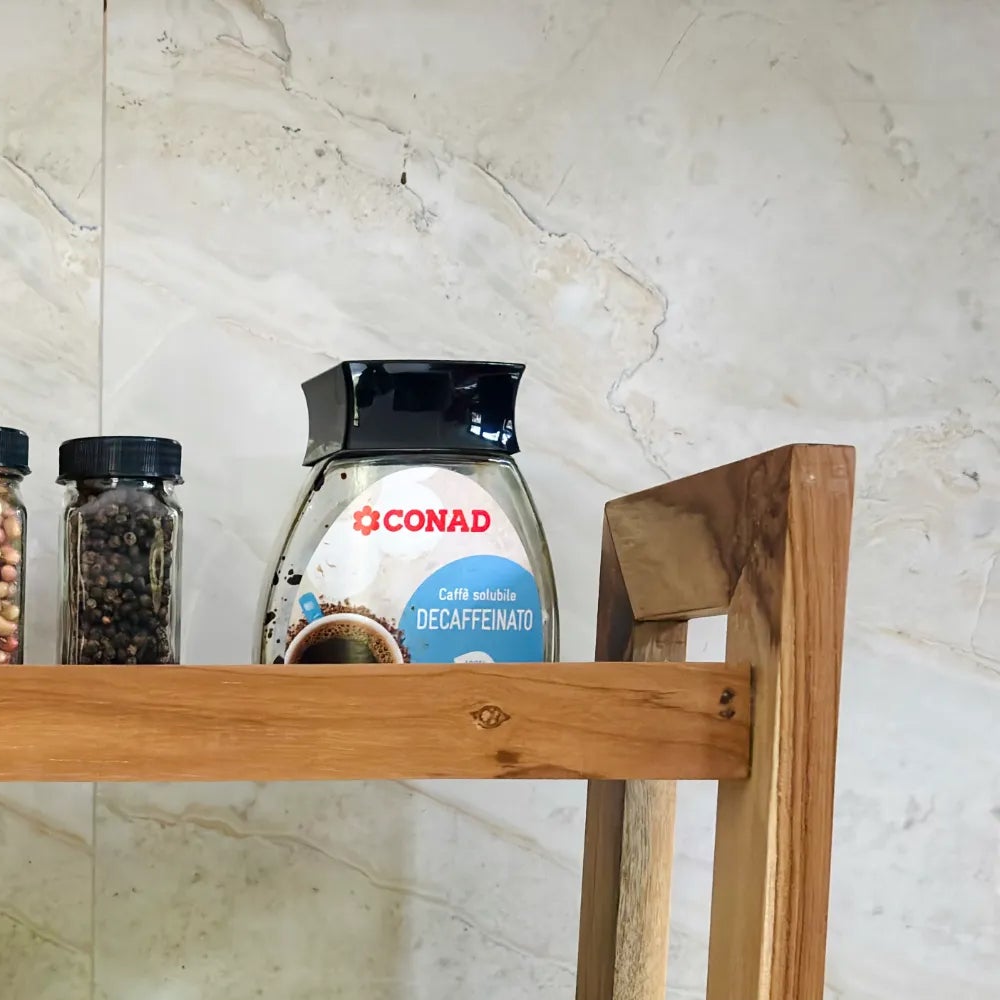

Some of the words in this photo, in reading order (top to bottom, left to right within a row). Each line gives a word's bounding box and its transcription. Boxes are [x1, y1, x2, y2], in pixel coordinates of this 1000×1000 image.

[383, 509, 491, 532] CONAD
[438, 588, 469, 602] Caffè
[473, 588, 517, 602] solubile
[416, 608, 534, 631] DECAFFEINATO
